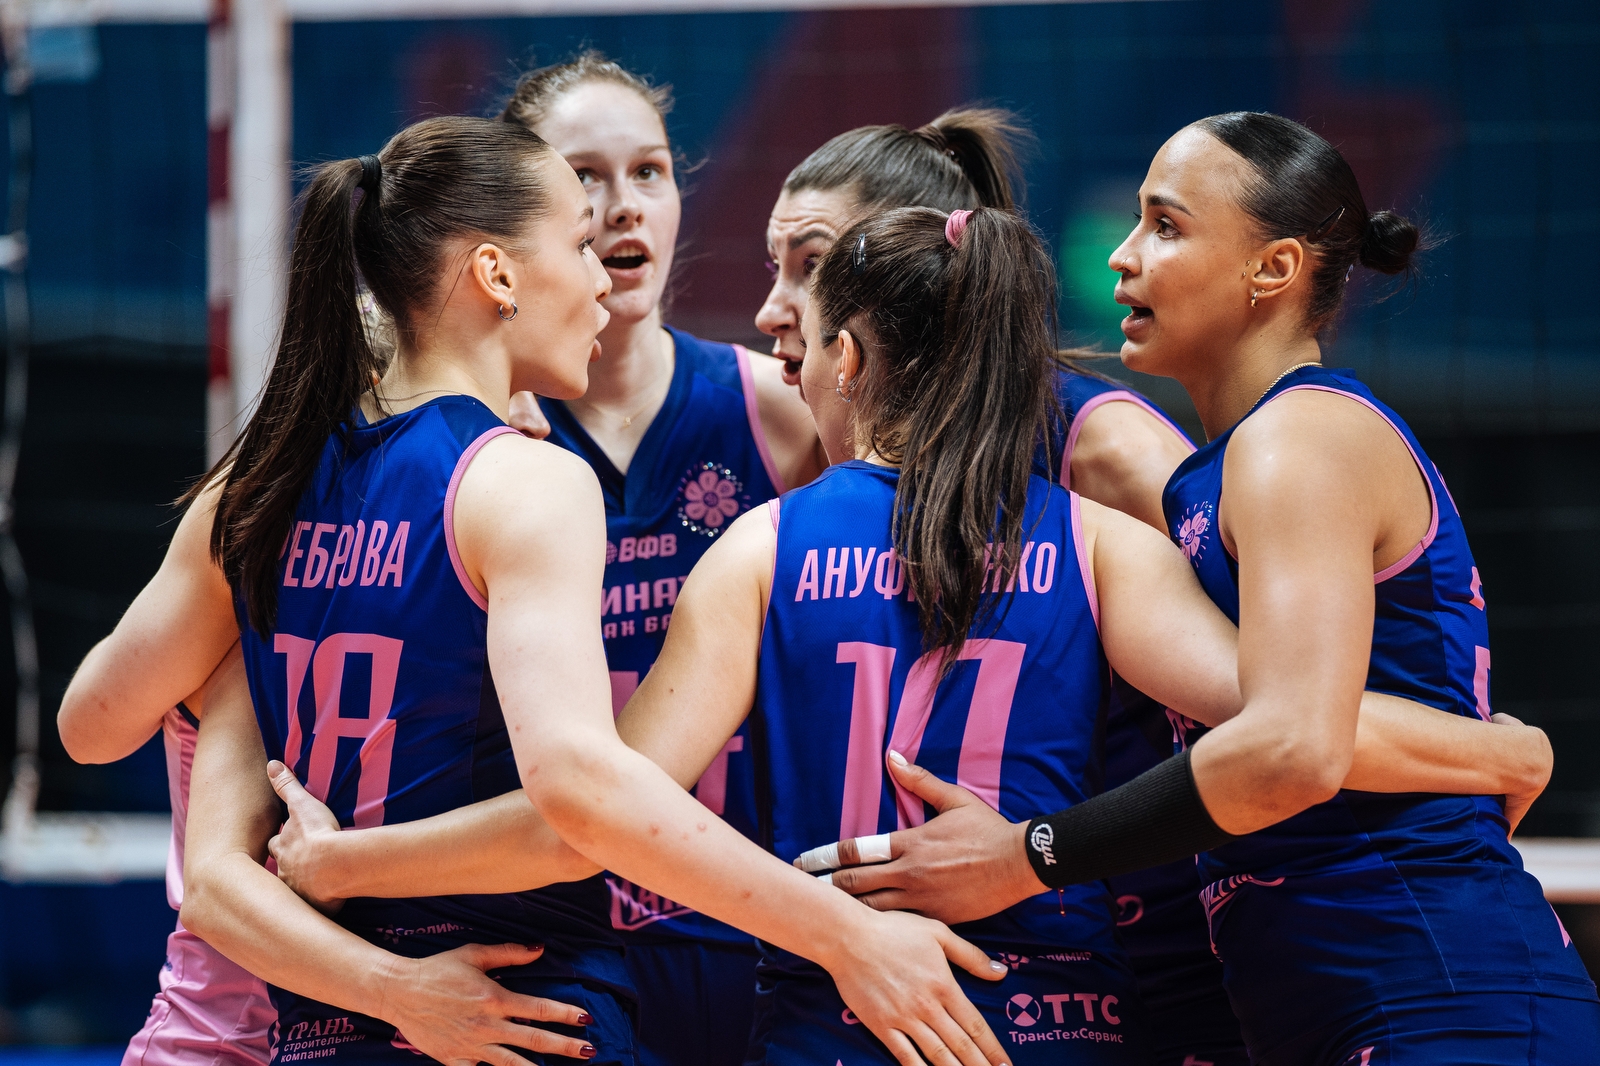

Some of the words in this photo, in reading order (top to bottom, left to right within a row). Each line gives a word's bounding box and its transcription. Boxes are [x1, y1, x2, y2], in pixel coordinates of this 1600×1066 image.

[277, 519, 411, 590] ЕБРОВА
[618, 533, 678, 563] ВФВ
[794, 541, 1058, 603] АНУФНКО
[273, 632, 404, 831] 18
[835, 637, 1028, 843] 10
[1042, 993, 1122, 1026] ТТС
[283, 1033, 367, 1053] строительная
[286, 1016, 356, 1042] ГРАНЬ
[1008, 1027, 1124, 1045] ТрансТехСервис
[280, 1047, 337, 1064] компания
